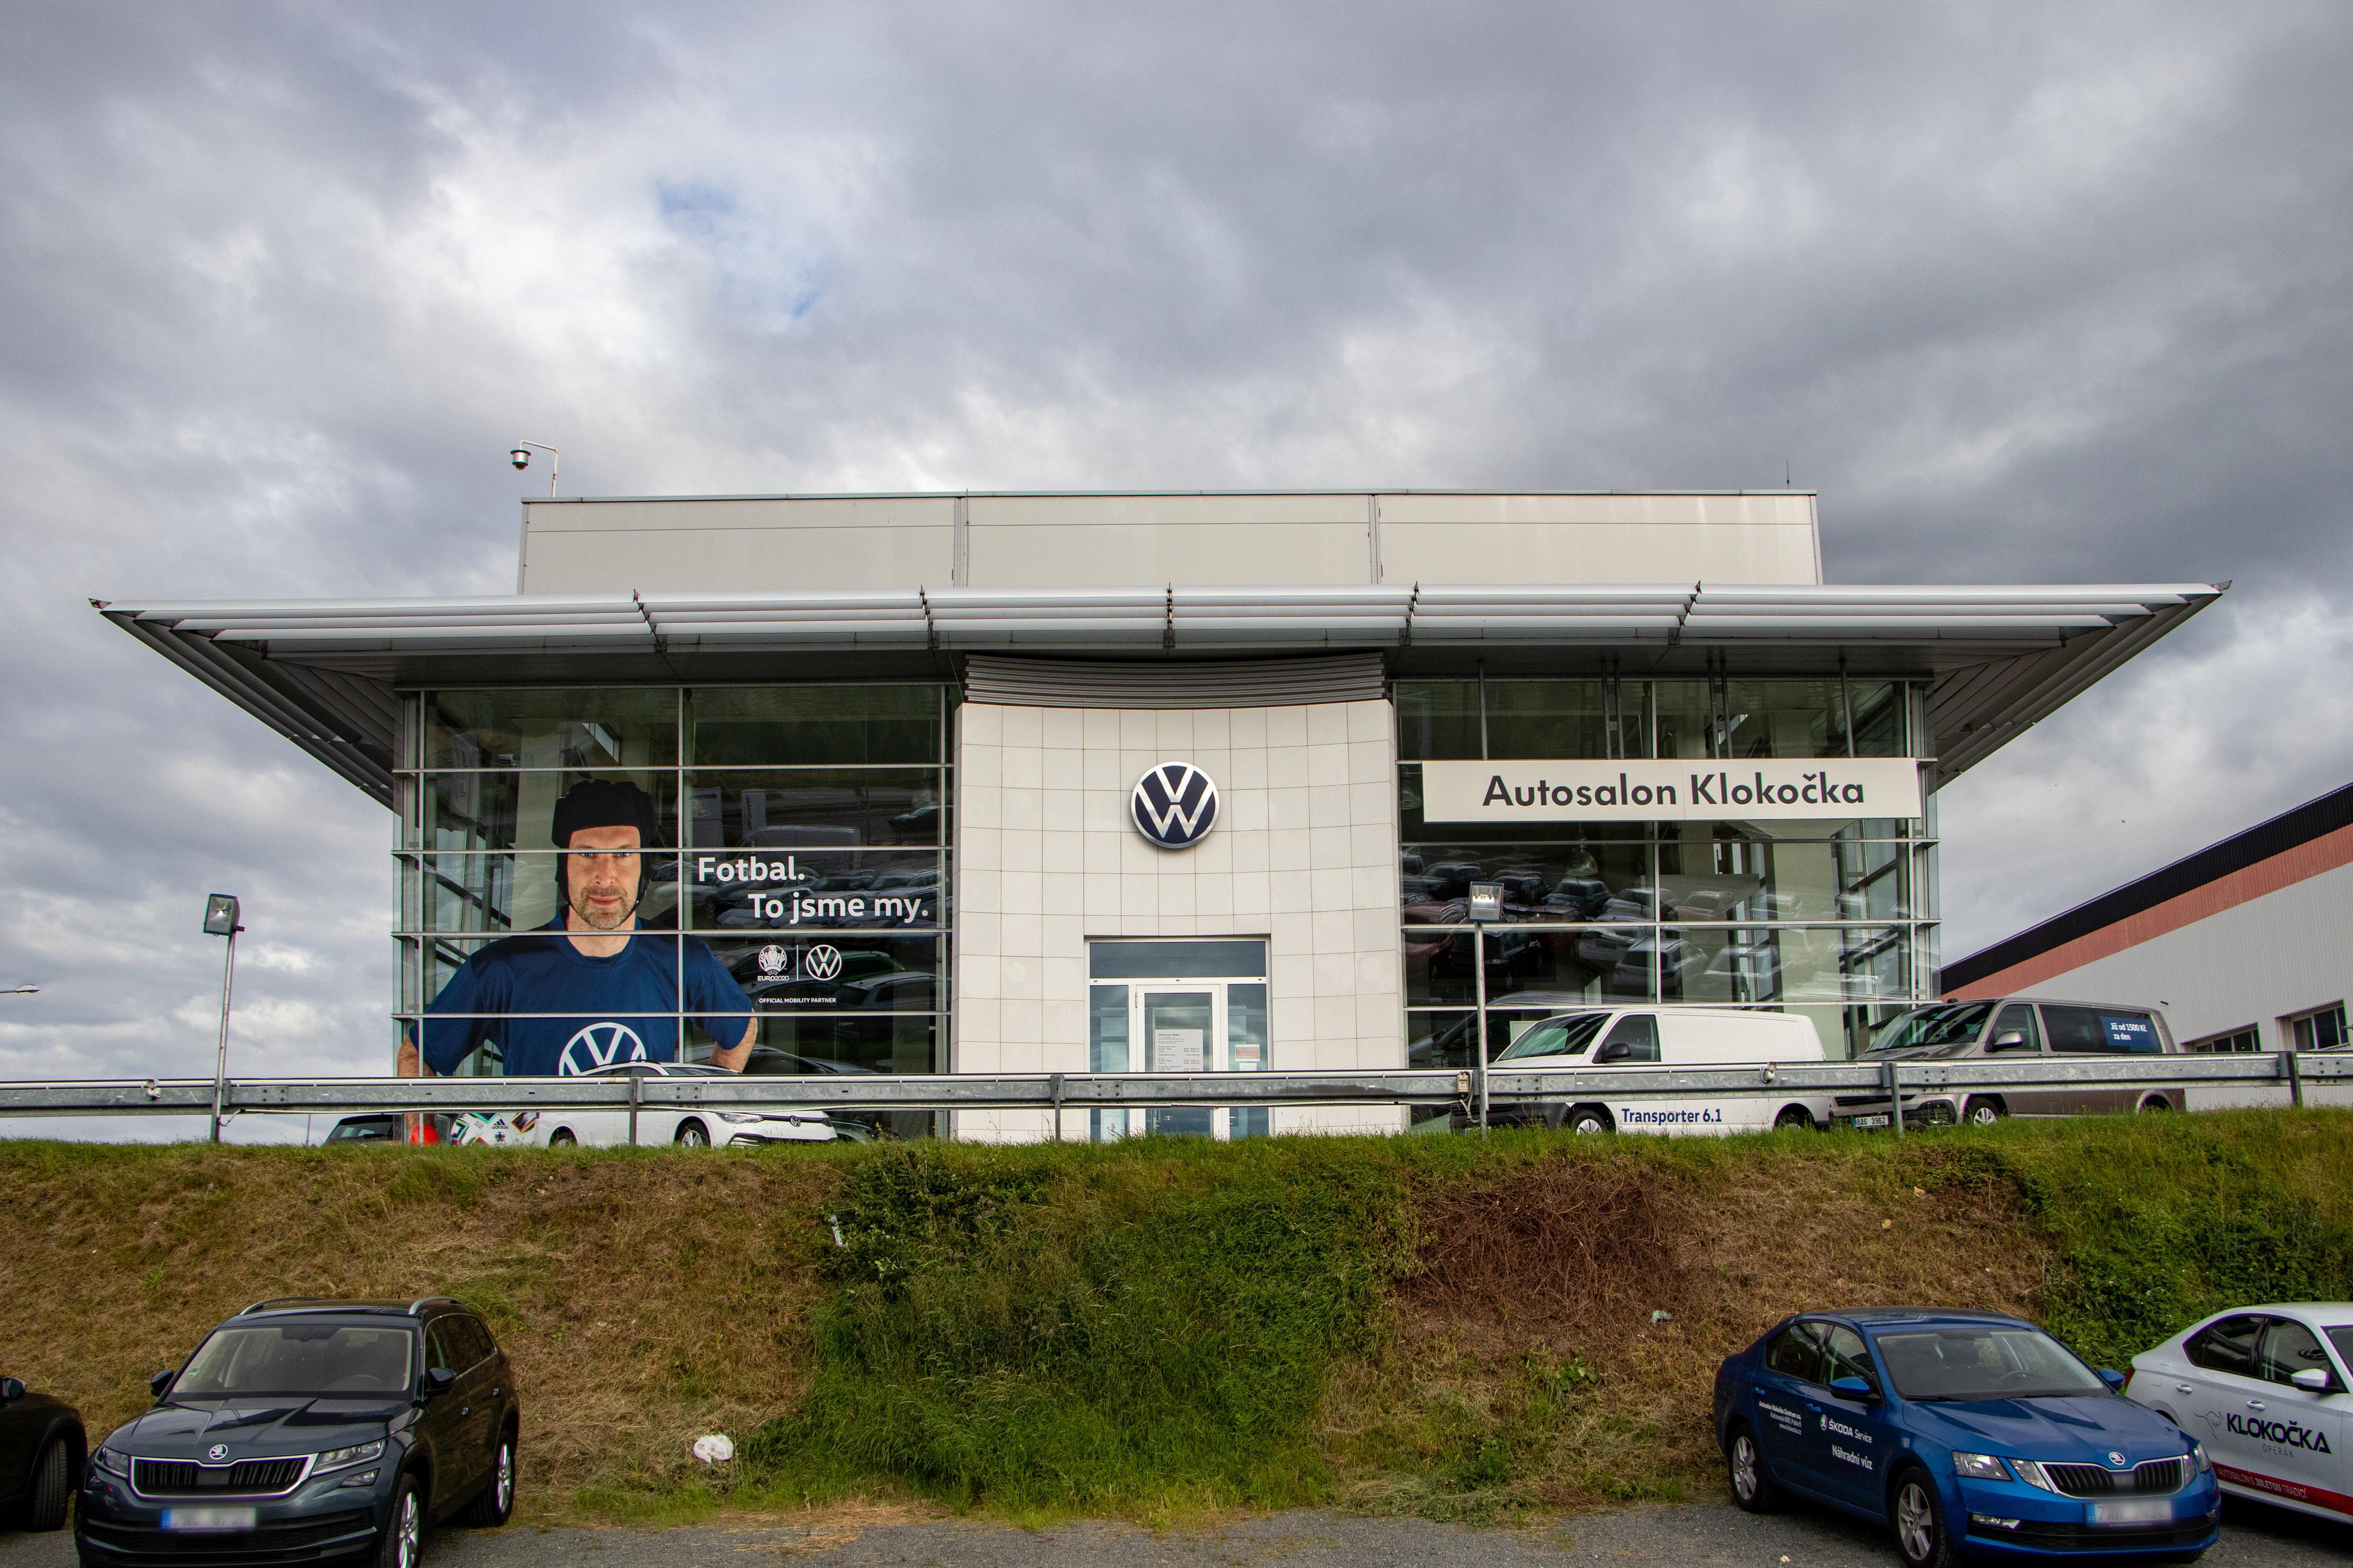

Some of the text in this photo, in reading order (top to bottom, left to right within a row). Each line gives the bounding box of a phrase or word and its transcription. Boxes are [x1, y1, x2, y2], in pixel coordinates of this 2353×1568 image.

[1482, 771, 1865, 806] Autosalon Klokočka
[698, 856, 805, 882] Fotbal.
[748, 891, 929, 925] To jsme my.
[2125, 1023, 2139, 1032] 1500
[1621, 1108, 1722, 1126] Transporter 6.1
[1871, 1116, 1886, 1125] 3962
[1828, 1418, 1872, 1443] ŠKODA Service
[2226, 1412, 2332, 1454] KLOKOČKA
[1832, 1444, 1873, 1470] Náhradní vůz
[2218, 1467, 2250, 1484] AUTOSALON
[2281, 1483, 2307, 1499] TRADICÍ
